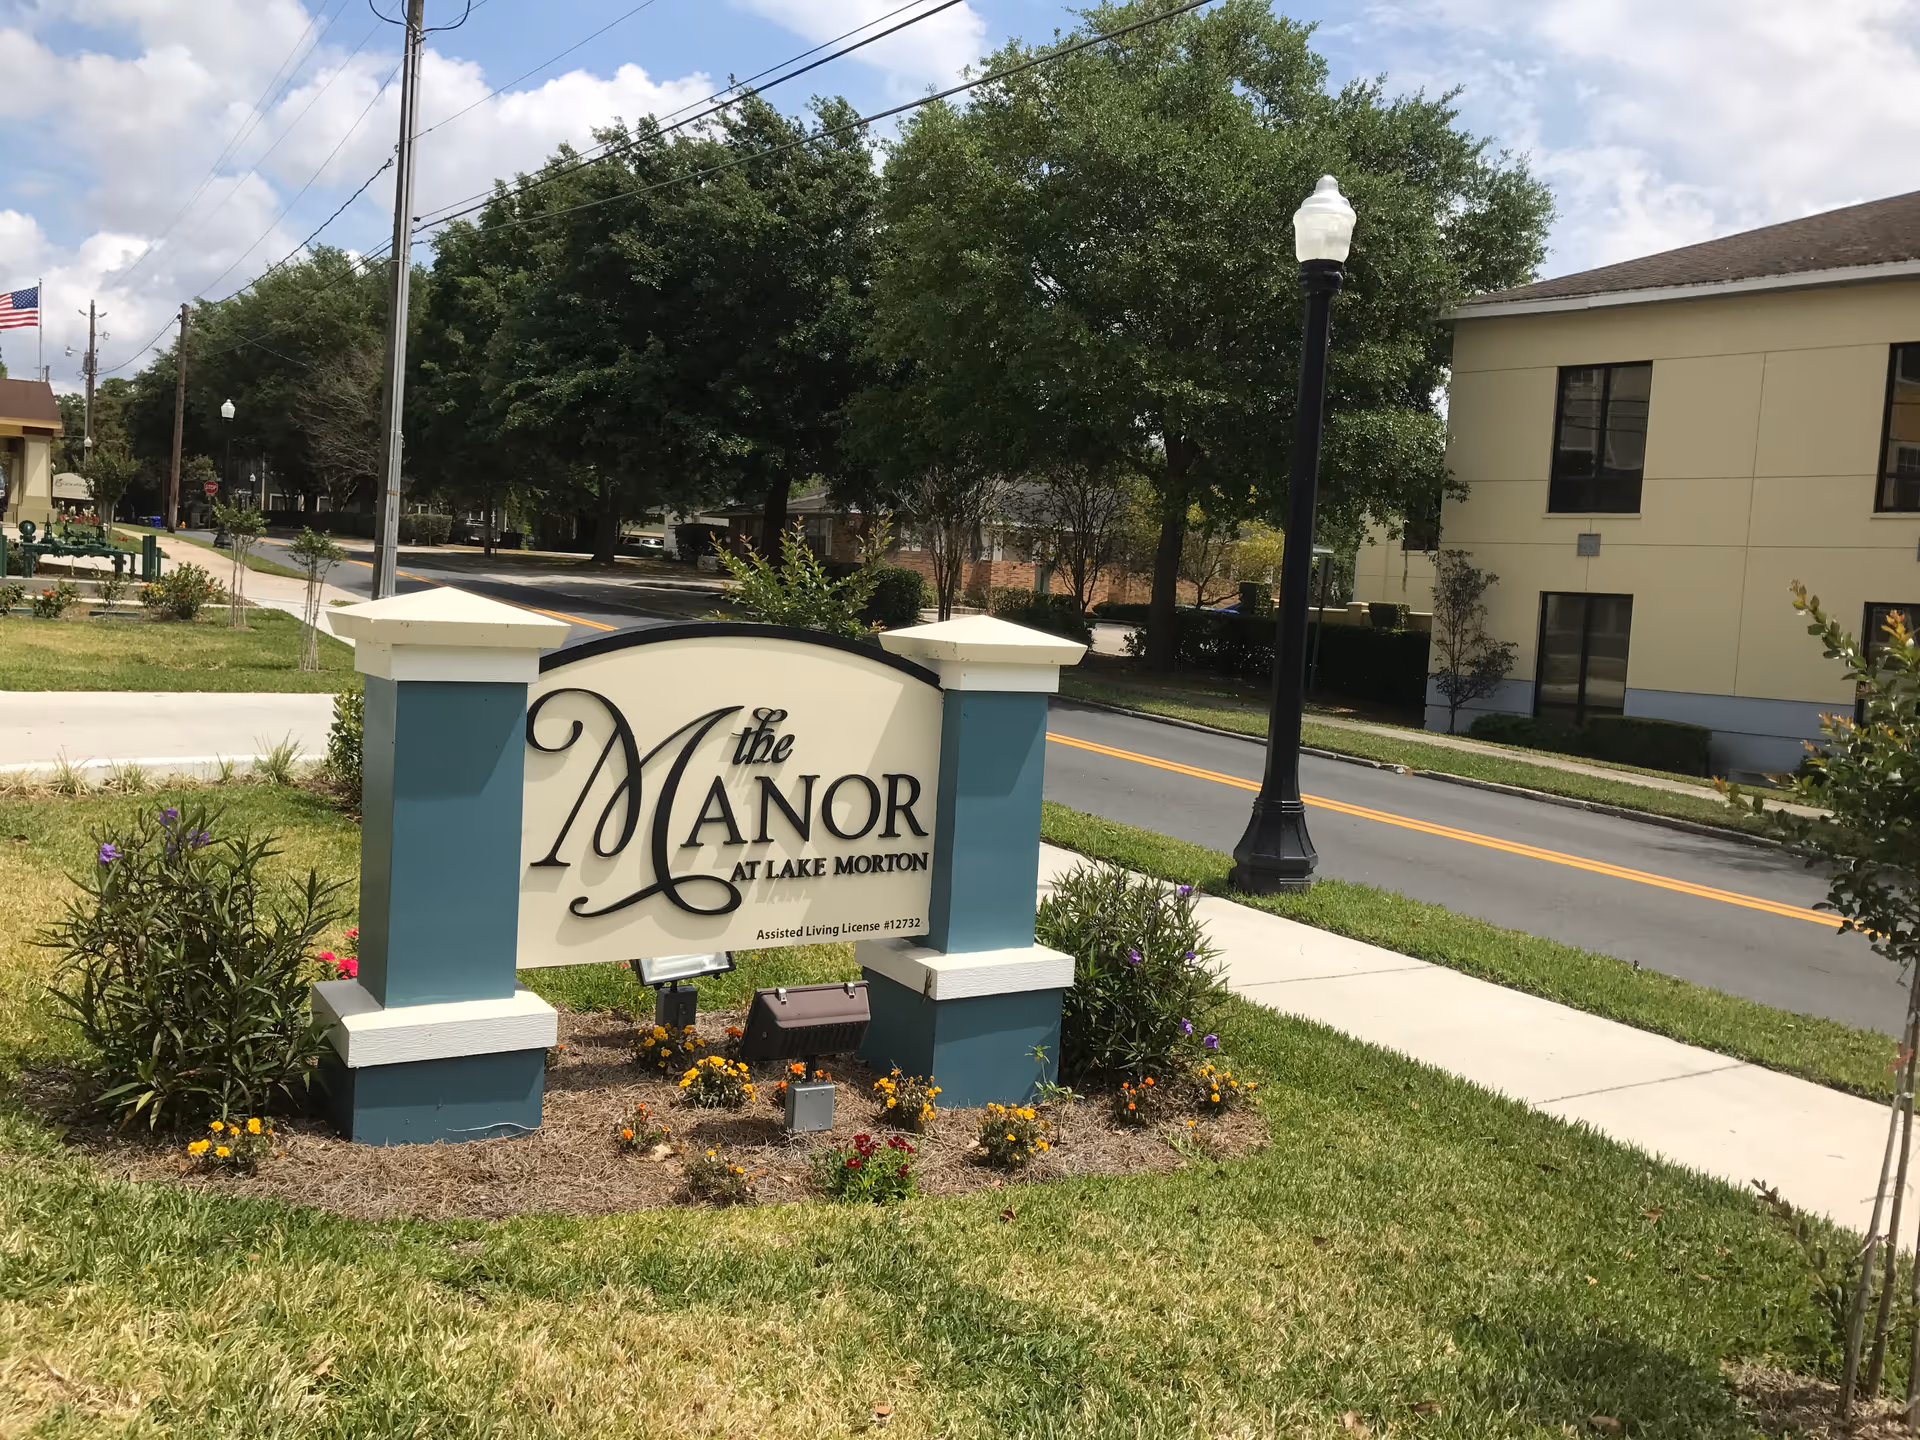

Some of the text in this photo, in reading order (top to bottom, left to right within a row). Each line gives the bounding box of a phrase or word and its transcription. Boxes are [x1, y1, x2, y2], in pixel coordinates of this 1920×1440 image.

[731, 707, 796, 765] the
[526, 687, 929, 918] MANOR
[729, 852, 929, 883] AT LAKE MORTON
[756, 917, 921, 940] Assisted Living License #12732
